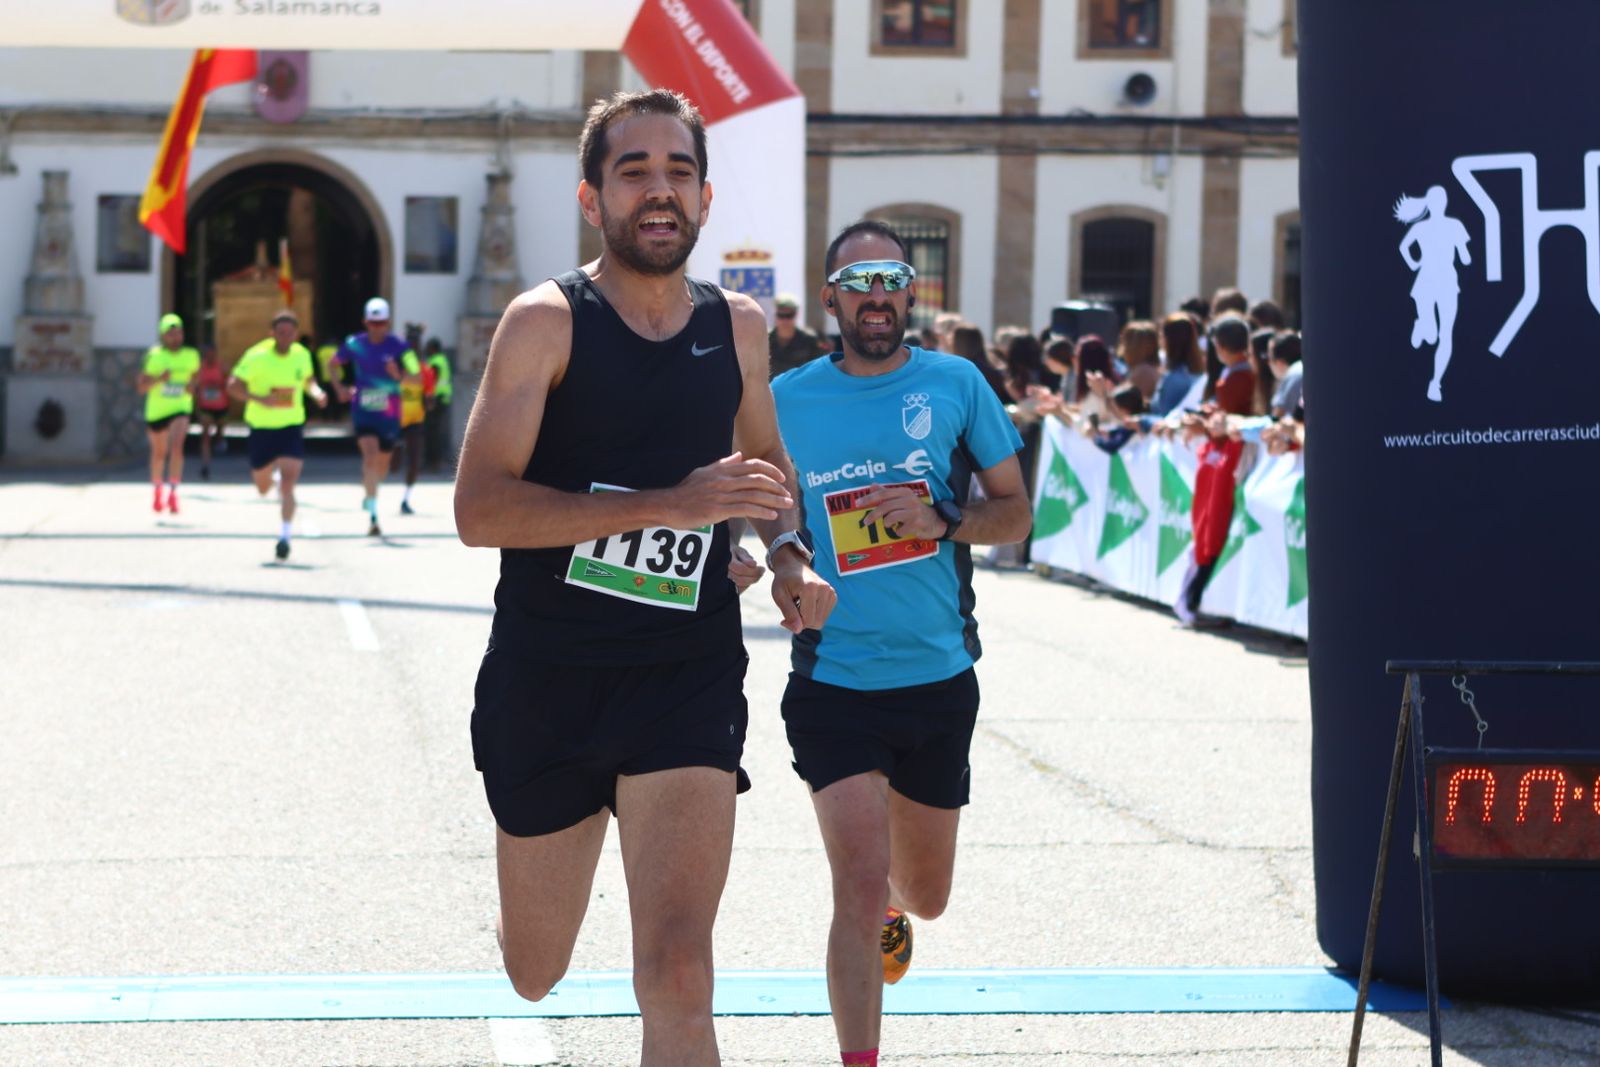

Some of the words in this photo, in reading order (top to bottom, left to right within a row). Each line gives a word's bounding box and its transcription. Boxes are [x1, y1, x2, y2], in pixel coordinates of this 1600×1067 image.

[236, 0, 382, 16] Salamanca
[696, 39, 751, 104] DEPORTE
[806, 459, 886, 488] iberCaja
